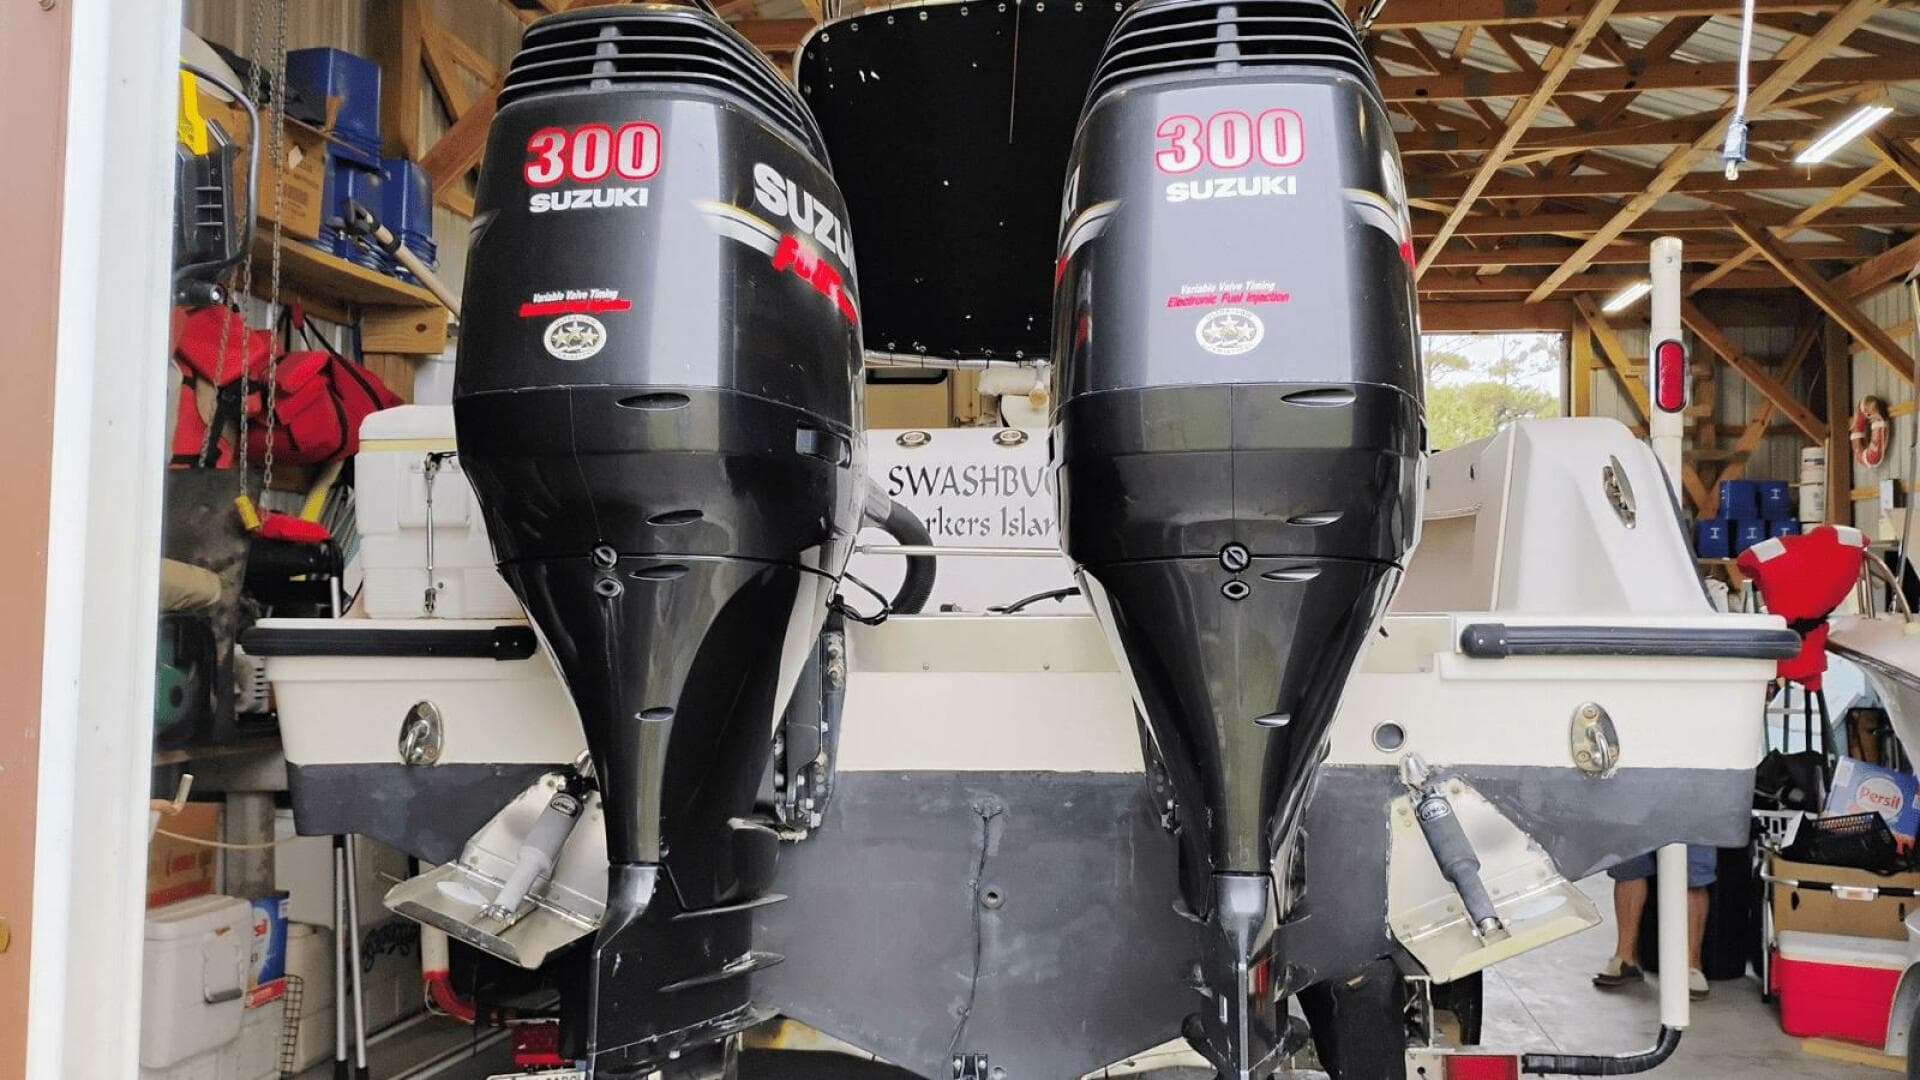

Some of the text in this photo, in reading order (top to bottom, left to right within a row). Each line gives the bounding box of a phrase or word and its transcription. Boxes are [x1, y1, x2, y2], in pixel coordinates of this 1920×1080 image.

[524, 121, 662, 187] 300
[1155, 108, 1305, 174] 300
[529, 187, 648, 213] SUZUKI
[1166, 175, 1297, 202] SUZUKI
[753, 162, 853, 272] SUZU
[1166, 291, 1291, 308] Electronic Fuel Injection
[926, 506, 991, 537] rkers
[1859, 786, 1901, 810] Persil
